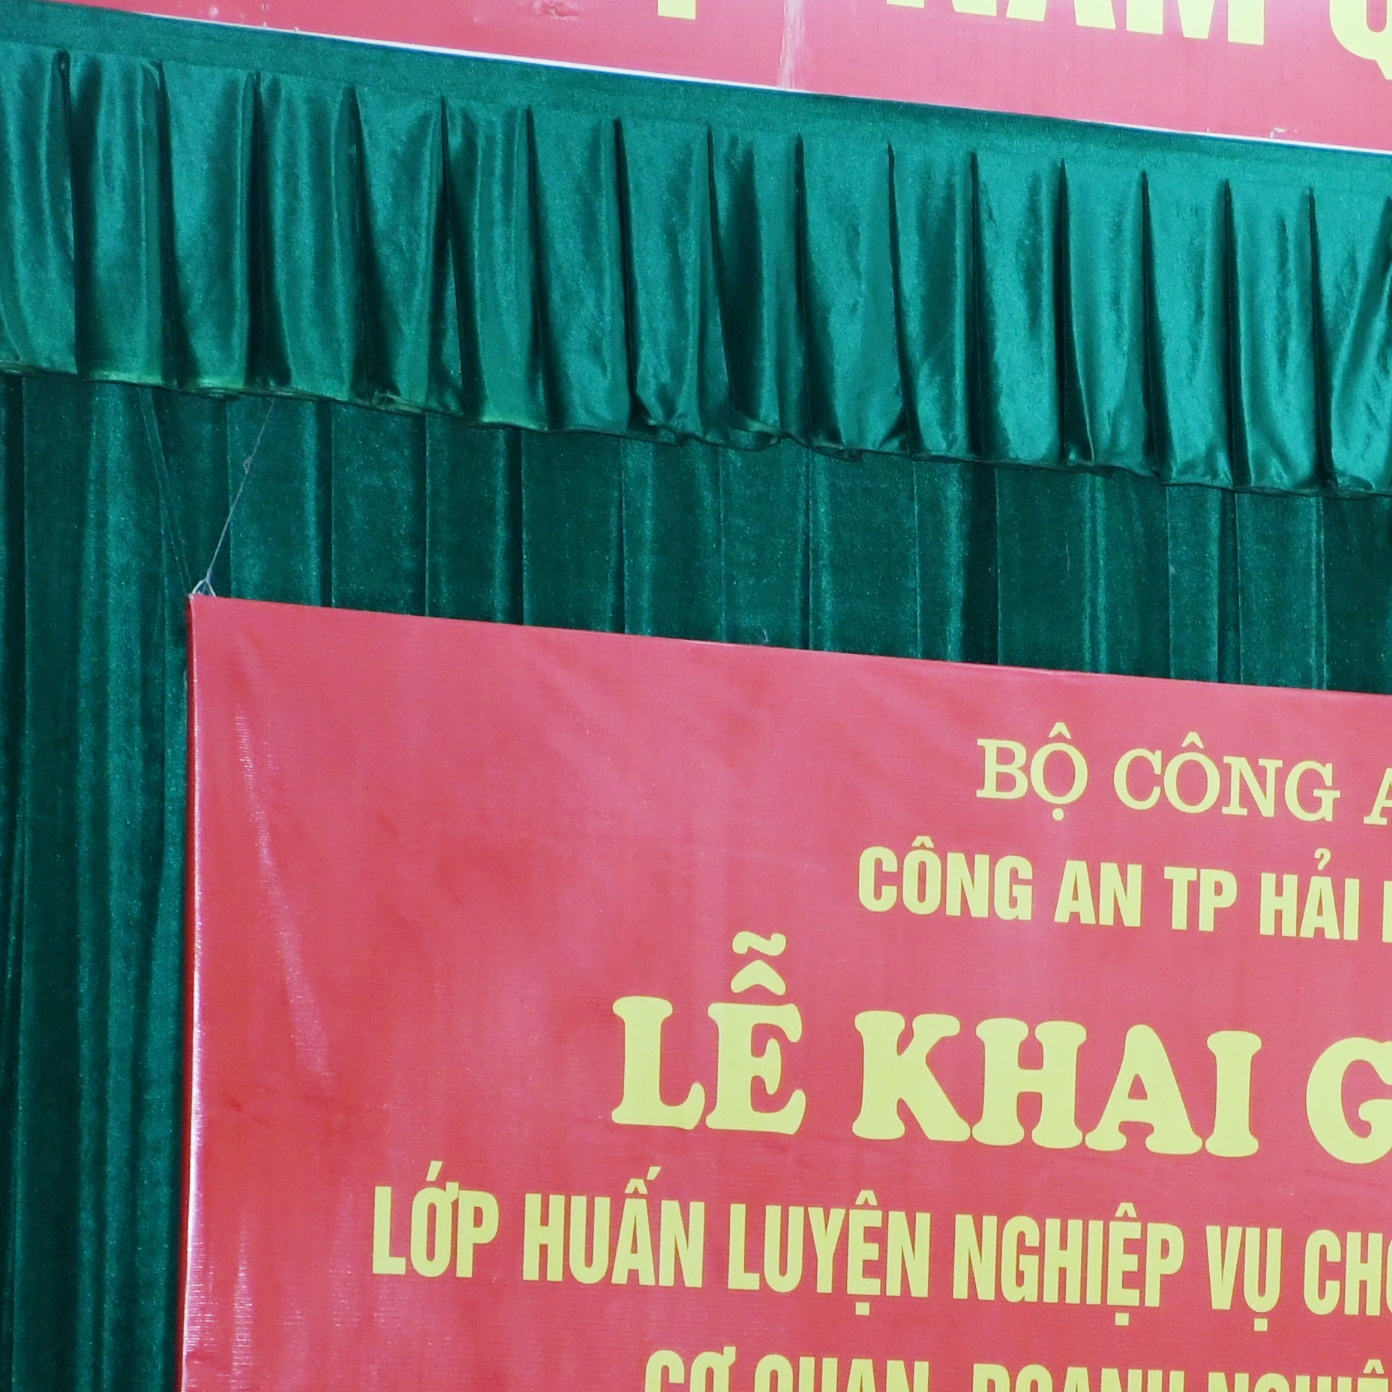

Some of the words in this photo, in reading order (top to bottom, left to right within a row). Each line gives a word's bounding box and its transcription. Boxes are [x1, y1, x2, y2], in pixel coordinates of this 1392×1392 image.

[976, 721, 1089, 822] BỘ
[1113, 731, 1342, 823] CÔNG
[858, 834, 1034, 922] CÔNG
[1053, 858, 1143, 928] AN
[1163, 865, 1239, 933] TP
[1259, 847, 1361, 941] HẢI
[610, 930, 807, 1136] LỄ
[851, 1009, 1263, 1158] KHAI
[372, 1159, 500, 1278] LỚP
[522, 1165, 706, 1289] HUẤN
[727, 1189, 932, 1317] LUYỆN
[952, 1201, 1185, 1327] NGHIỆP
[1205, 1224, 1283, 1332] VỤ
